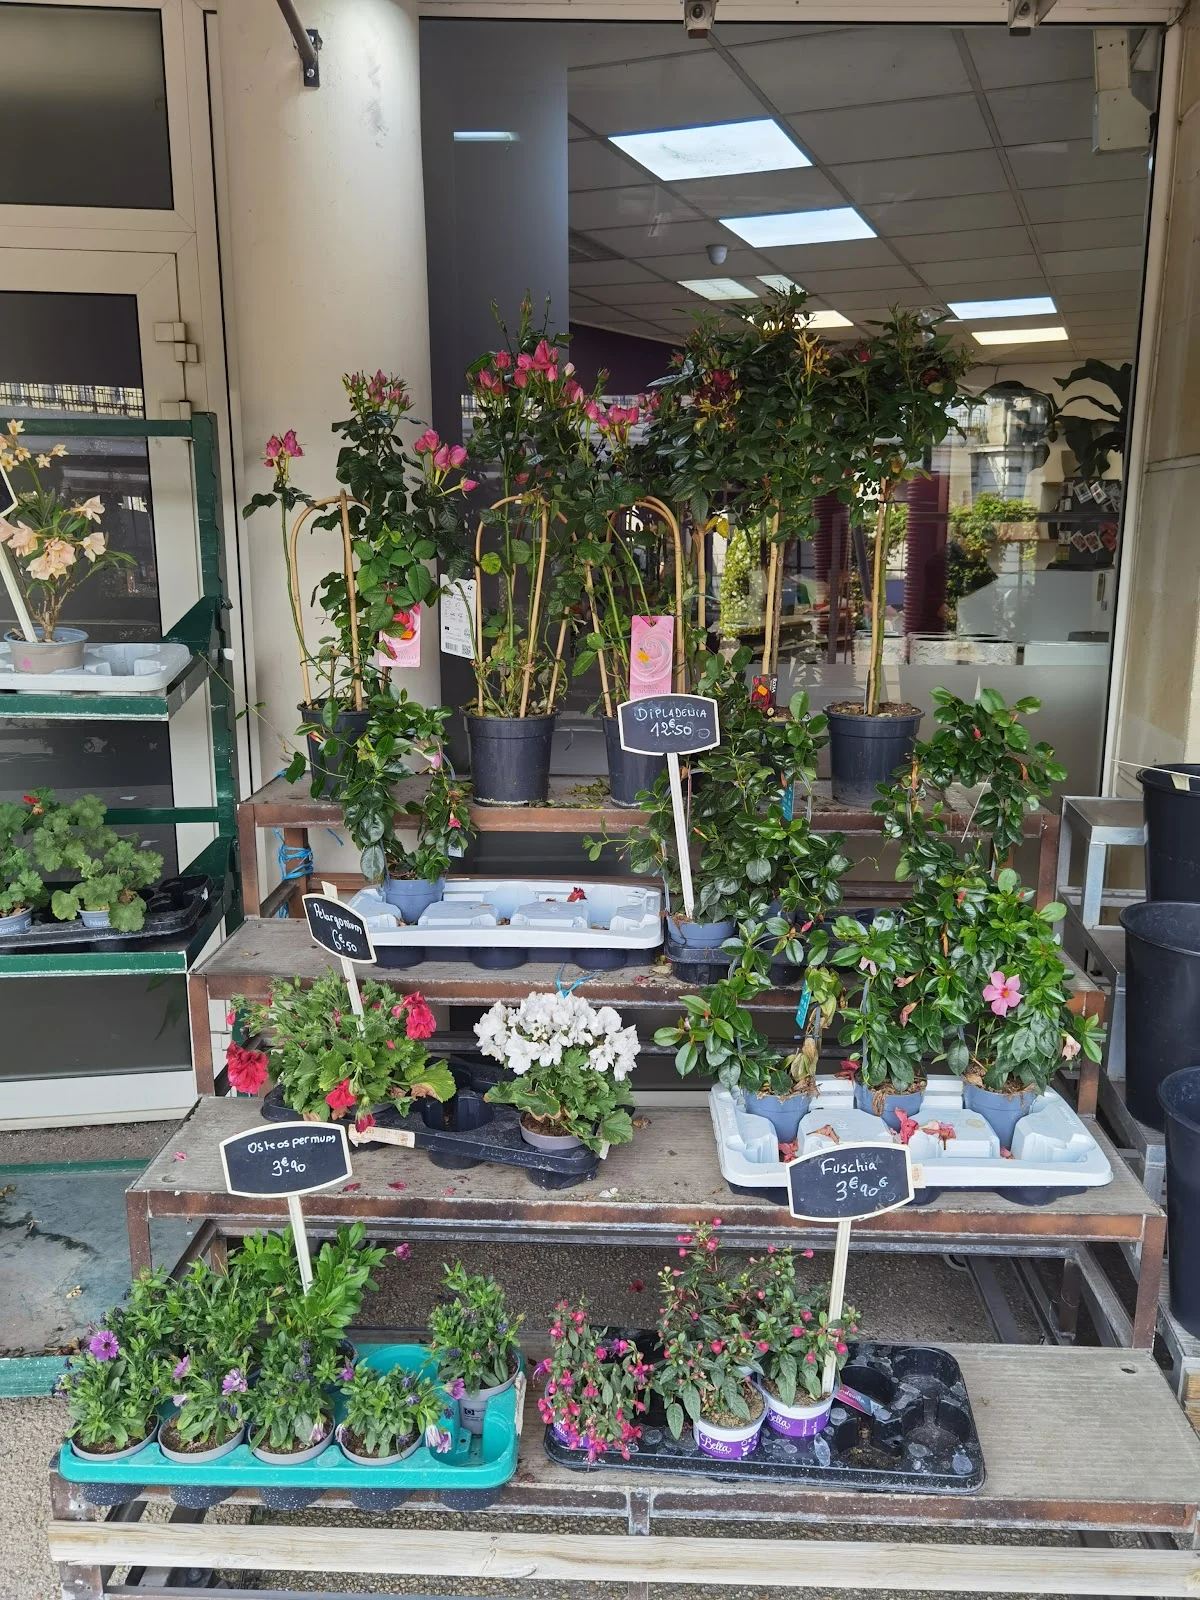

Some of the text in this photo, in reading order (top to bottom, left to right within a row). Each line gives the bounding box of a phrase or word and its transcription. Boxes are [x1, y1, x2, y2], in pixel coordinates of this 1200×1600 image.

[313, 903, 362, 935] Pelargonium
[820, 1157, 877, 1175] Fuschia
[700, 1434, 732, 1453] Bella
